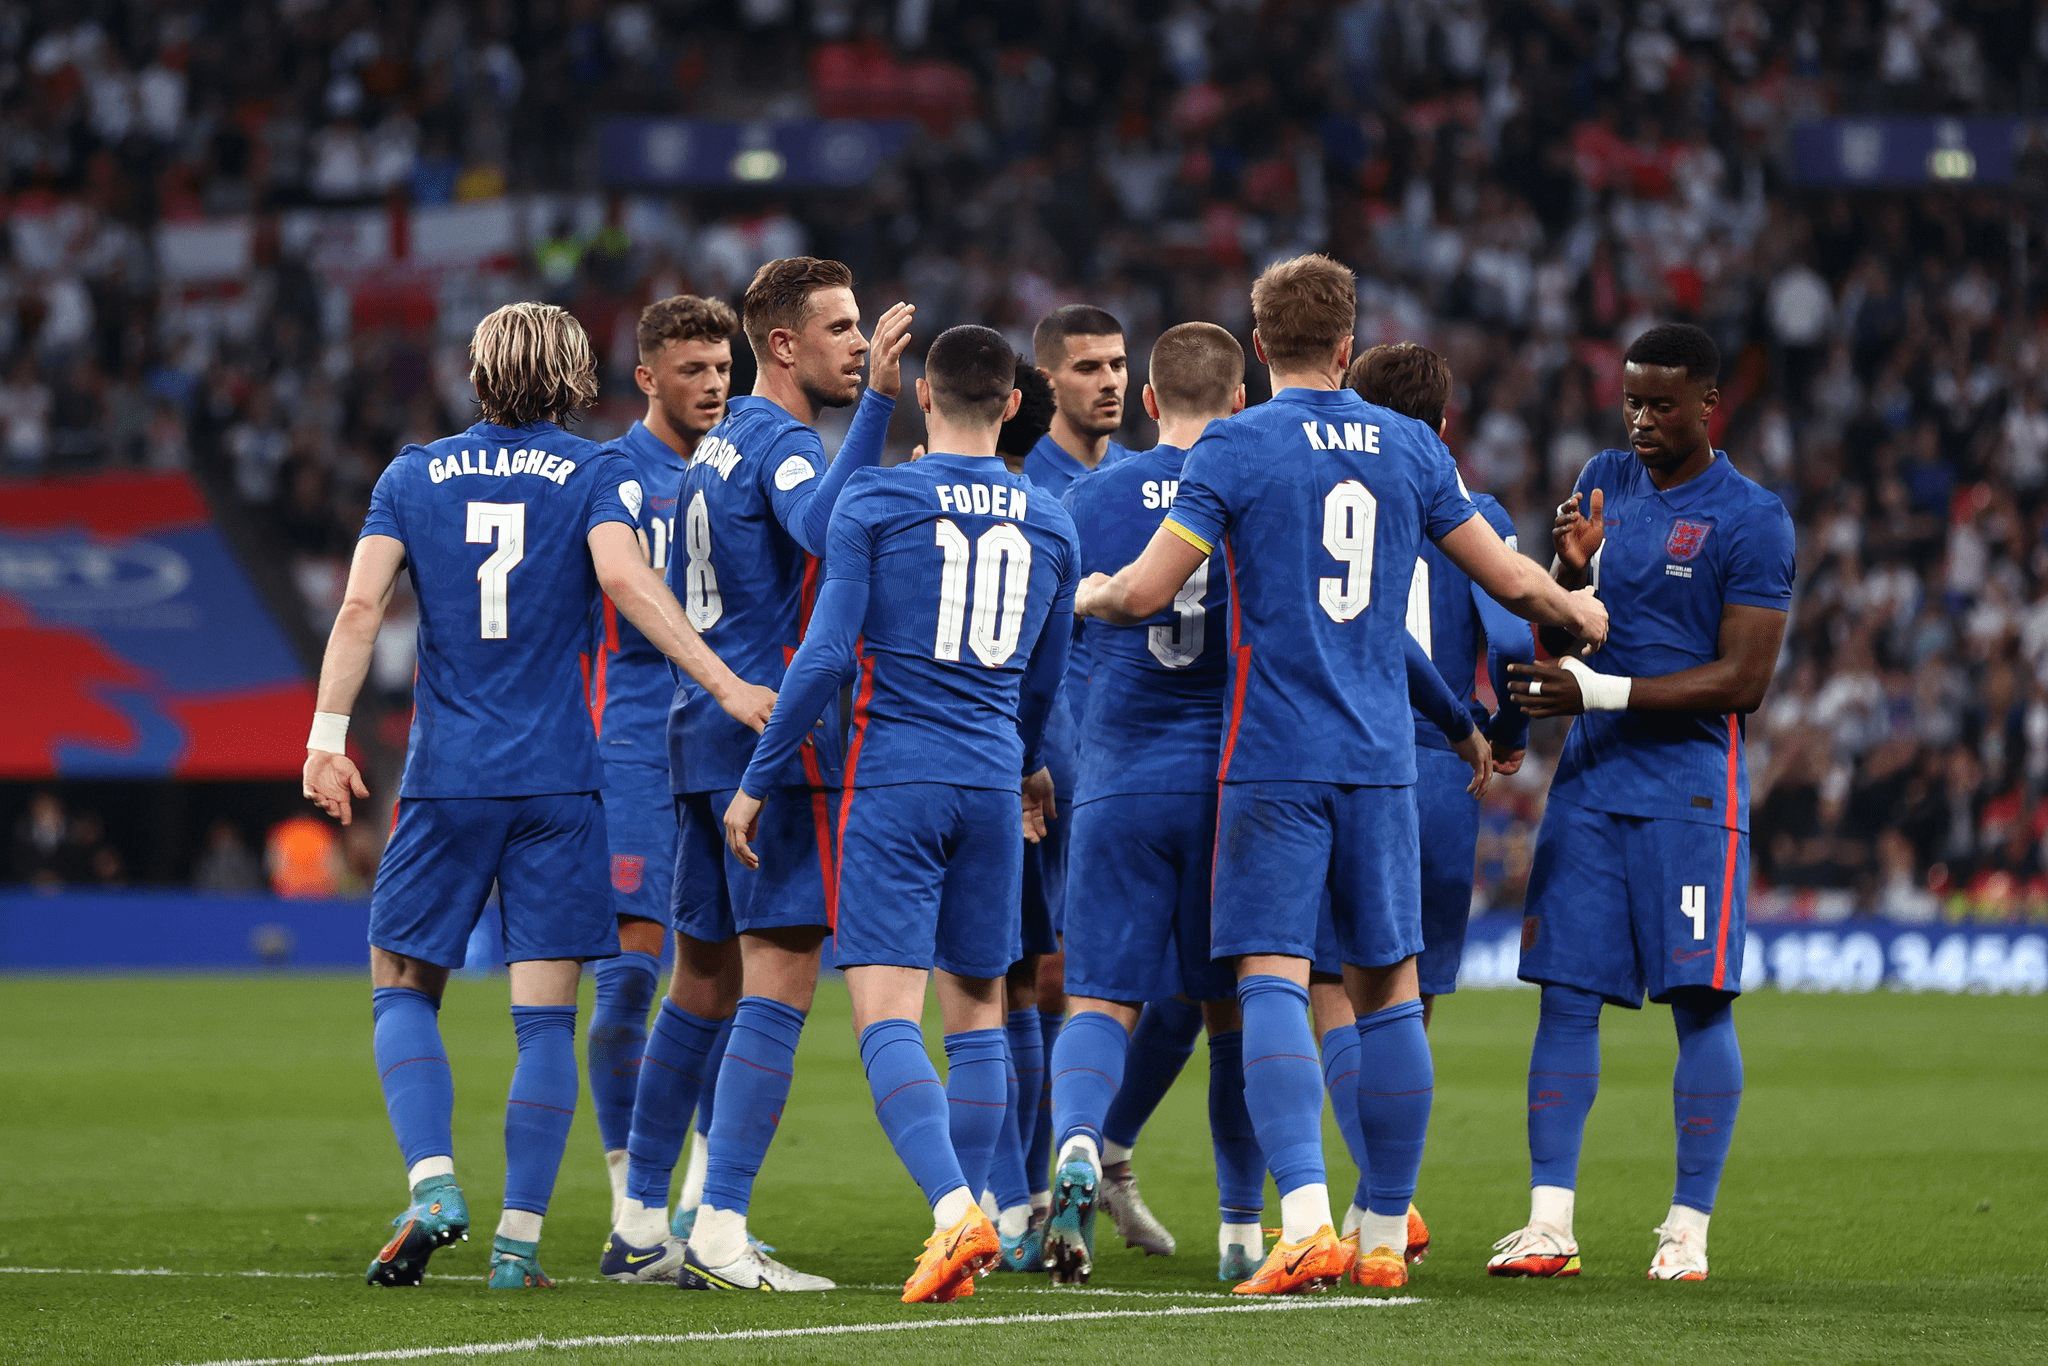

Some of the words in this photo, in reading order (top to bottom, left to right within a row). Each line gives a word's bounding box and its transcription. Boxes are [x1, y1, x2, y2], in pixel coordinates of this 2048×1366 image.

[1302, 421, 1380, 455] KANE
[428, 448, 576, 485] GALLAGHER
[935, 484, 1027, 521] FODEN
[1141, 480, 1179, 510] SH
[651, 516, 675, 568] 1
[686, 489, 723, 633] 8
[1318, 479, 1377, 623] 9
[465, 501, 526, 639] 7
[934, 518, 1032, 669] 10
[1680, 885, 1705, 940] 4
